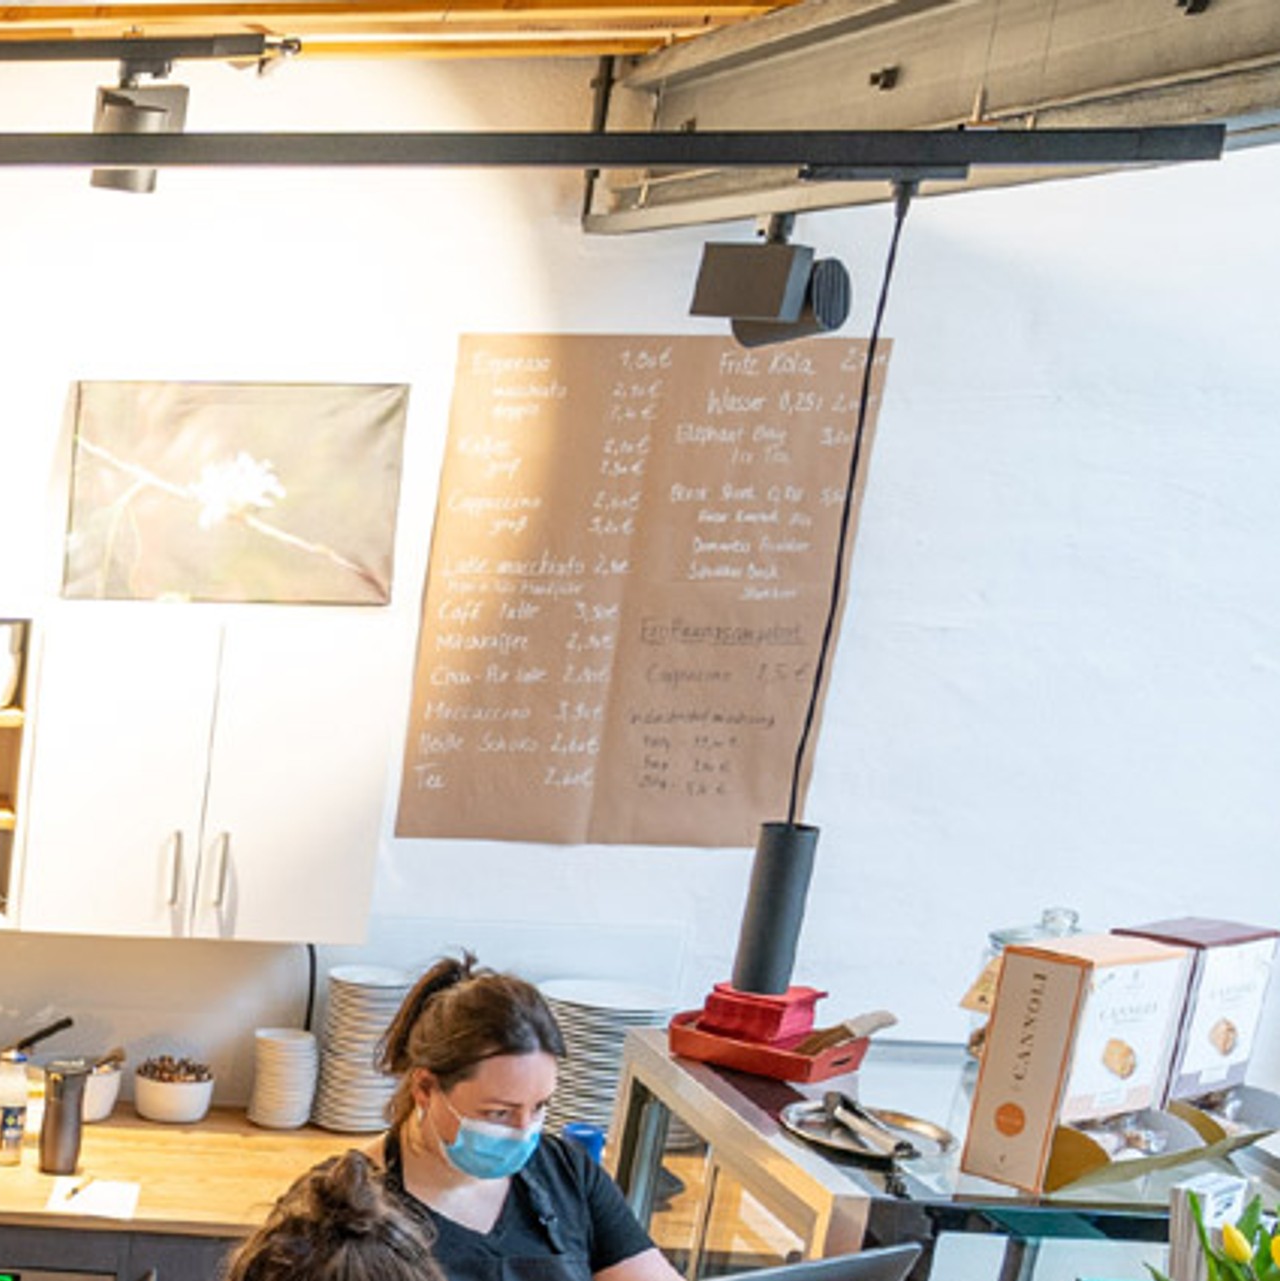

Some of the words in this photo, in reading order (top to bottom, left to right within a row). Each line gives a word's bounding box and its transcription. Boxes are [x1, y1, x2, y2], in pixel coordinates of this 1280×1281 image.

[719, 350, 760, 377] Fritz
[768, 349, 817, 377] Kola
[707, 387, 768, 415] Wasser
[412, 761, 445, 790] Tee
[1013, 972, 1047, 1081] CANNOLI
